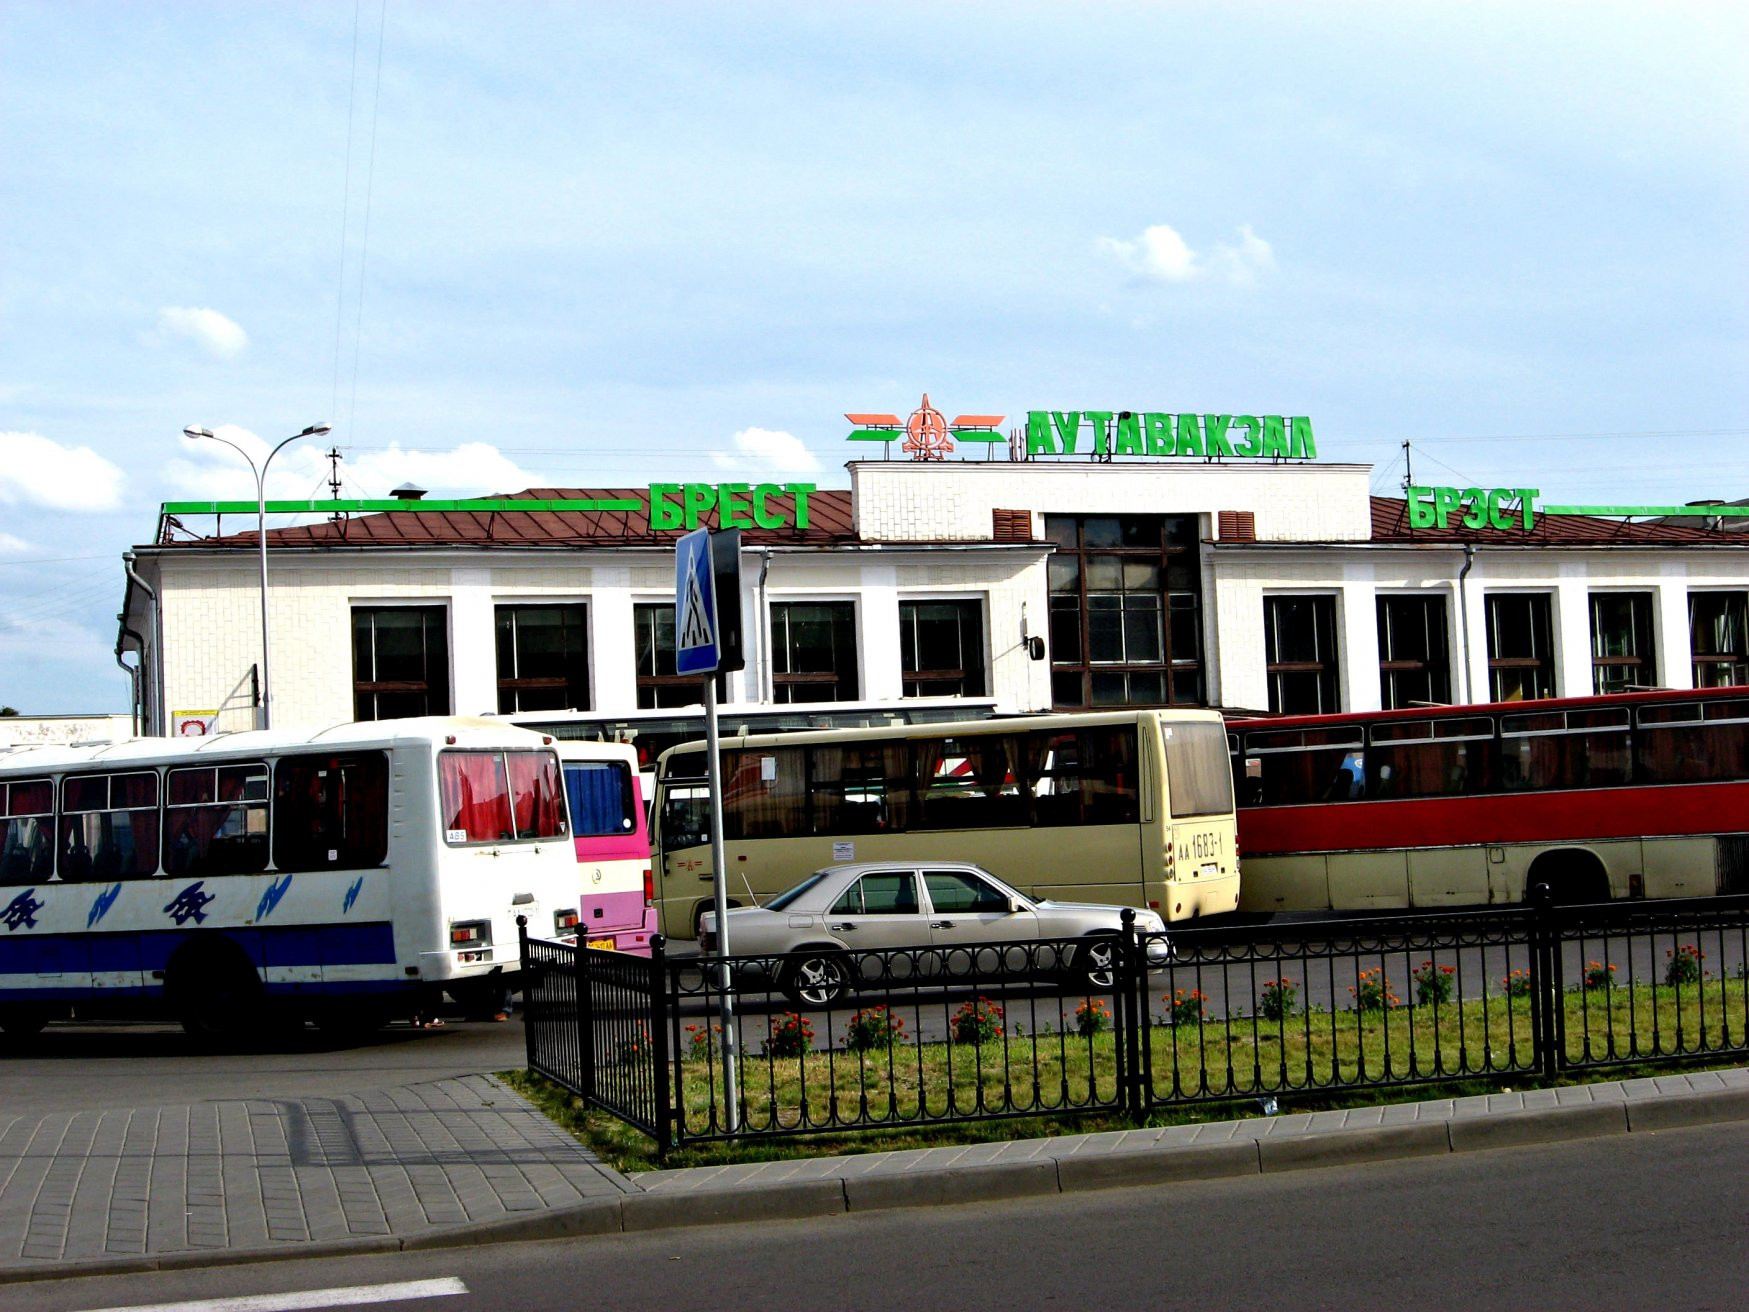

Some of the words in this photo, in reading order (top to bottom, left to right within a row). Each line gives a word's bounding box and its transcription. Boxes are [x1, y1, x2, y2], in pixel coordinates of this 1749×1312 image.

[1027, 411, 1316, 458] АУТАВАКЗАЛ
[649, 483, 817, 530] БРЕСТ
[1407, 486, 1540, 530] БРЭСТ
[1192, 832, 1223, 859] 1683-1
